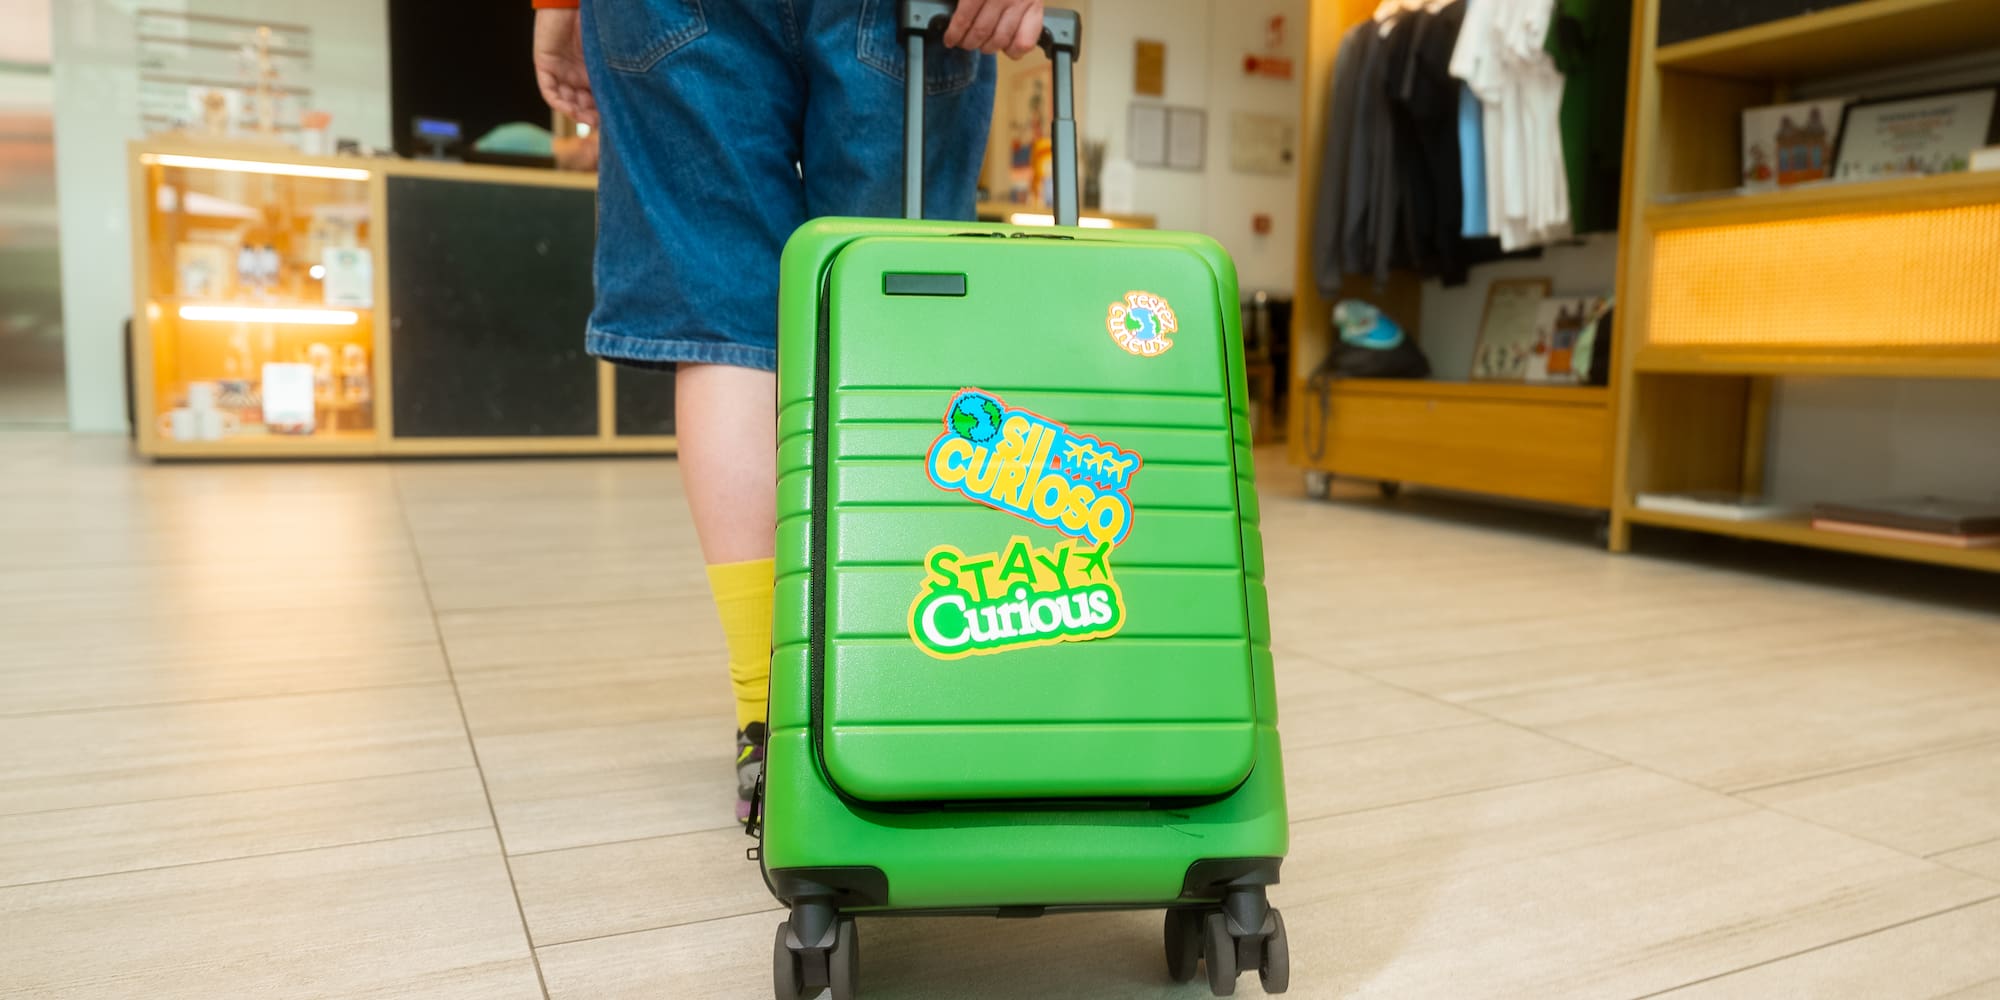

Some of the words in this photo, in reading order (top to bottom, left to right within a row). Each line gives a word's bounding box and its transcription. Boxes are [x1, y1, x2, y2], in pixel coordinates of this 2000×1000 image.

[1109, 305, 1170, 354] curieux
[1127, 294, 1175, 330] restez
[935, 437, 1125, 540] CURIOSO
[928, 542, 1070, 602] STAY
[921, 588, 1112, 647] Curious
